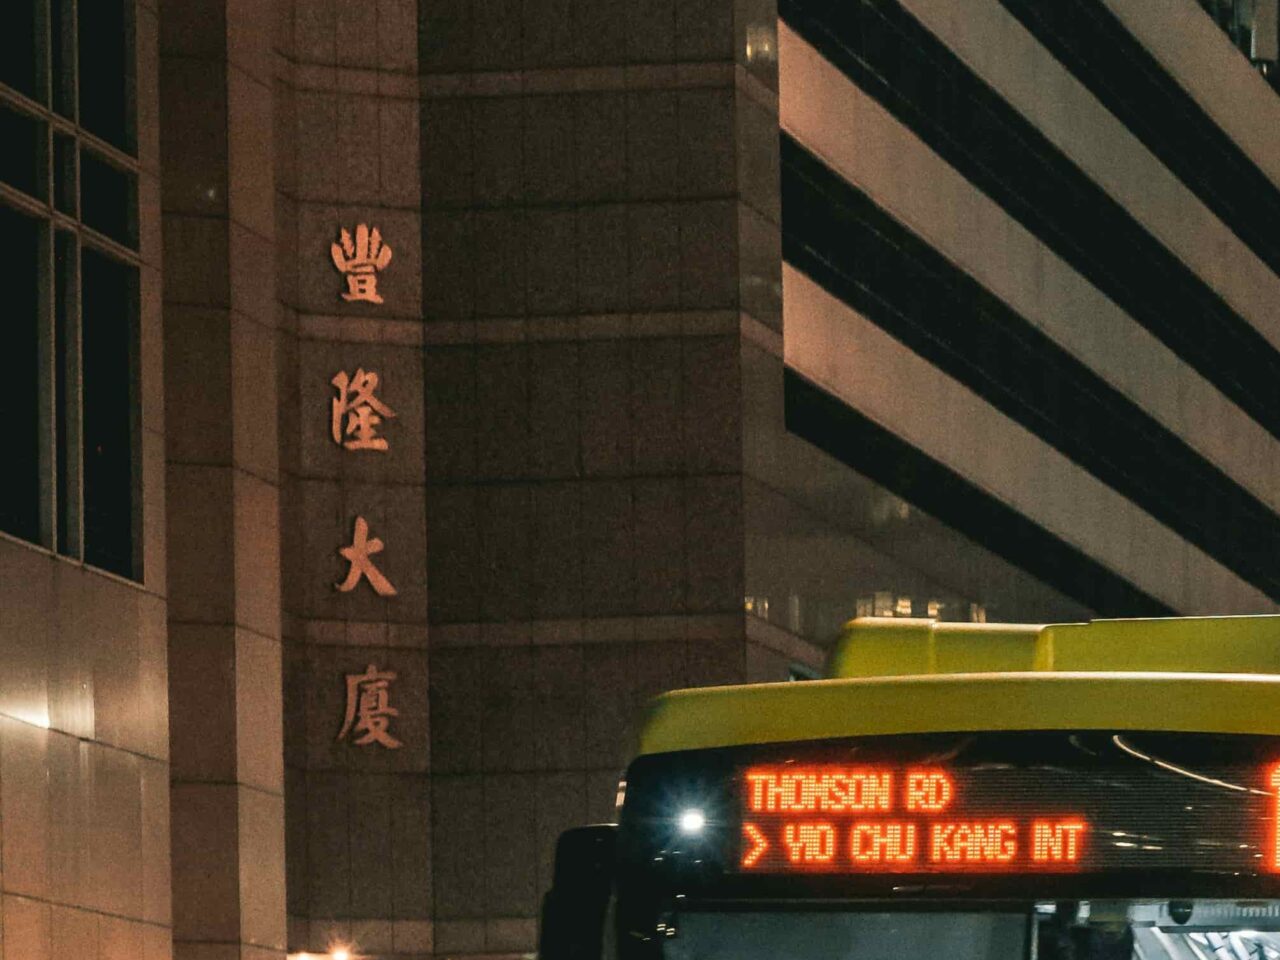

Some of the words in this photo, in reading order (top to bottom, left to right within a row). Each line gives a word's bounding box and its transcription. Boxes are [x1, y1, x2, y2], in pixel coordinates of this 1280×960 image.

[747, 773, 891, 811] THOMSON
[906, 773, 952, 811] RD
[785, 824, 835, 861] YIO
[852, 824, 915, 861] CHU
[931, 824, 1016, 861] KANG
[1031, 823, 1084, 861] INT
